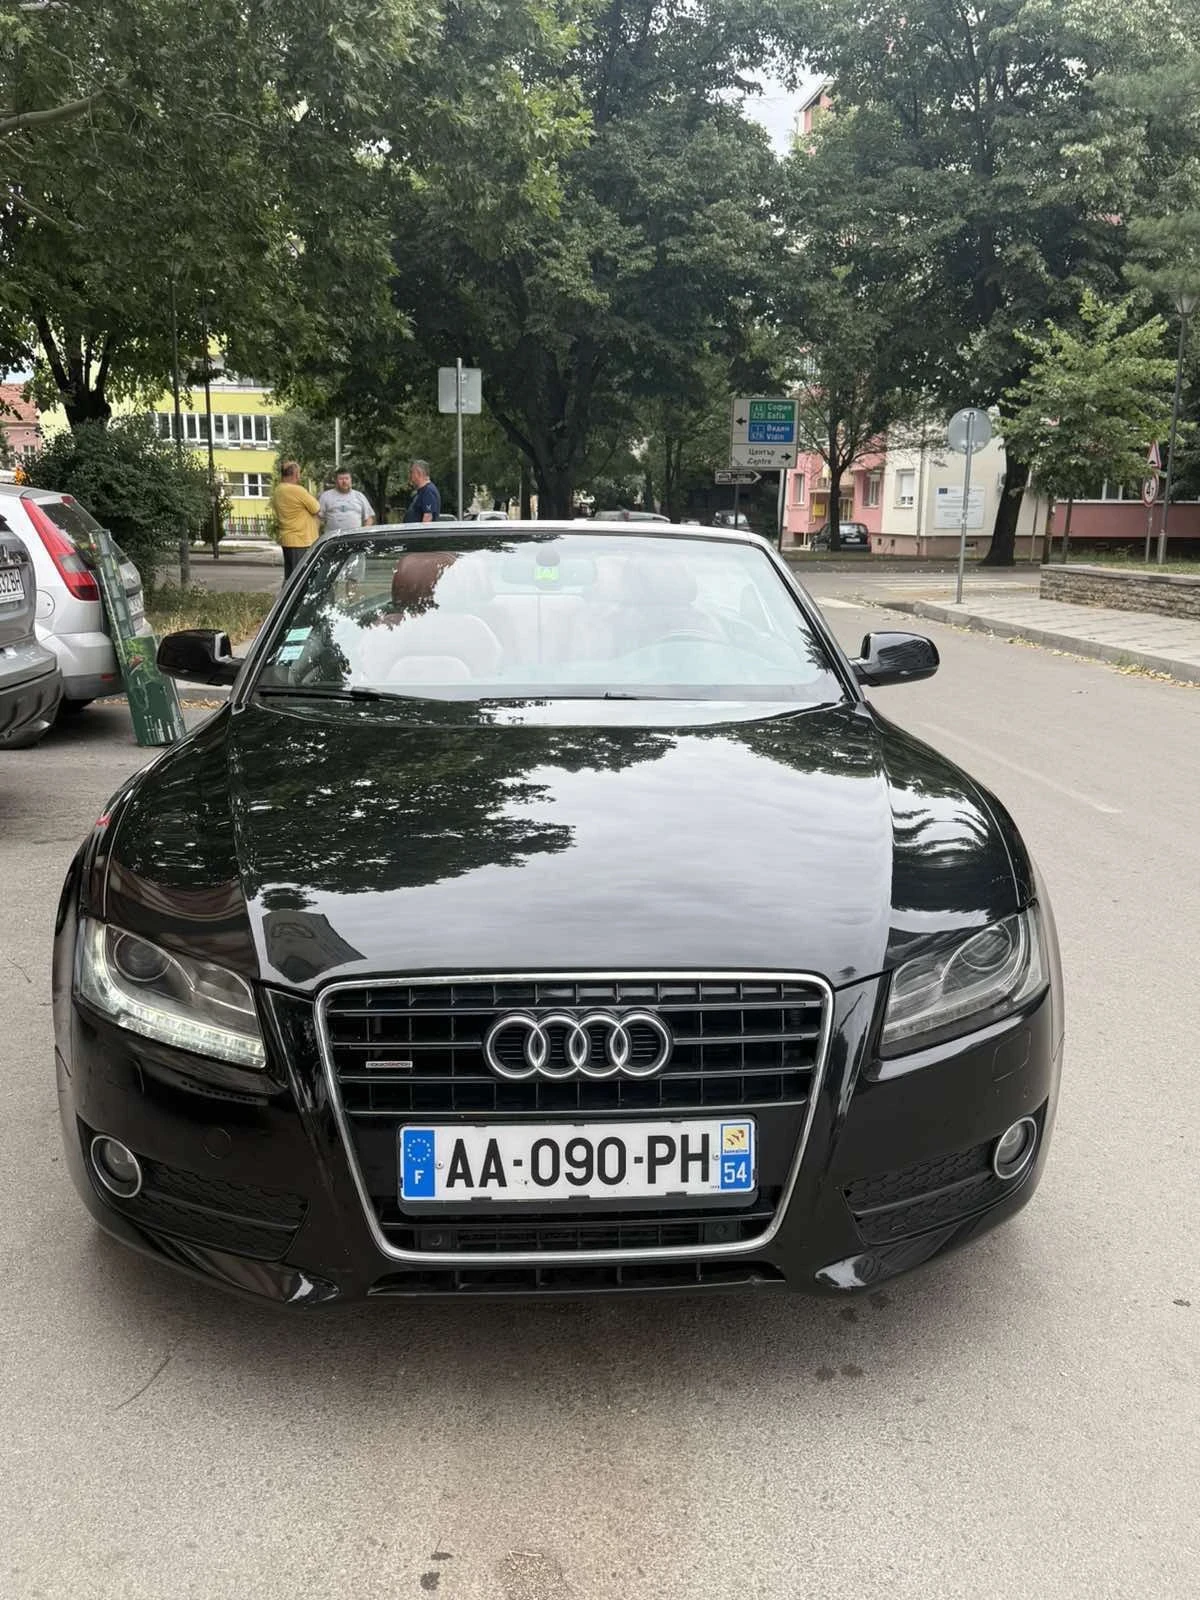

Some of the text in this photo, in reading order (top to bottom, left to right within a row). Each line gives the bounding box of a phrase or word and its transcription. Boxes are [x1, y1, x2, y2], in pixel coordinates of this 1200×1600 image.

[767, 411, 785, 419] Sofia
[767, 424, 790, 432] Видин
[766, 432, 784, 440] Vidin
[748, 447, 775, 456] Център
[746, 457, 772, 465] Centre
[445, 1133, 710, 1188] AA-090-PH
[724, 1161, 747, 1183] 54
[414, 1171, 424, 1185] F
